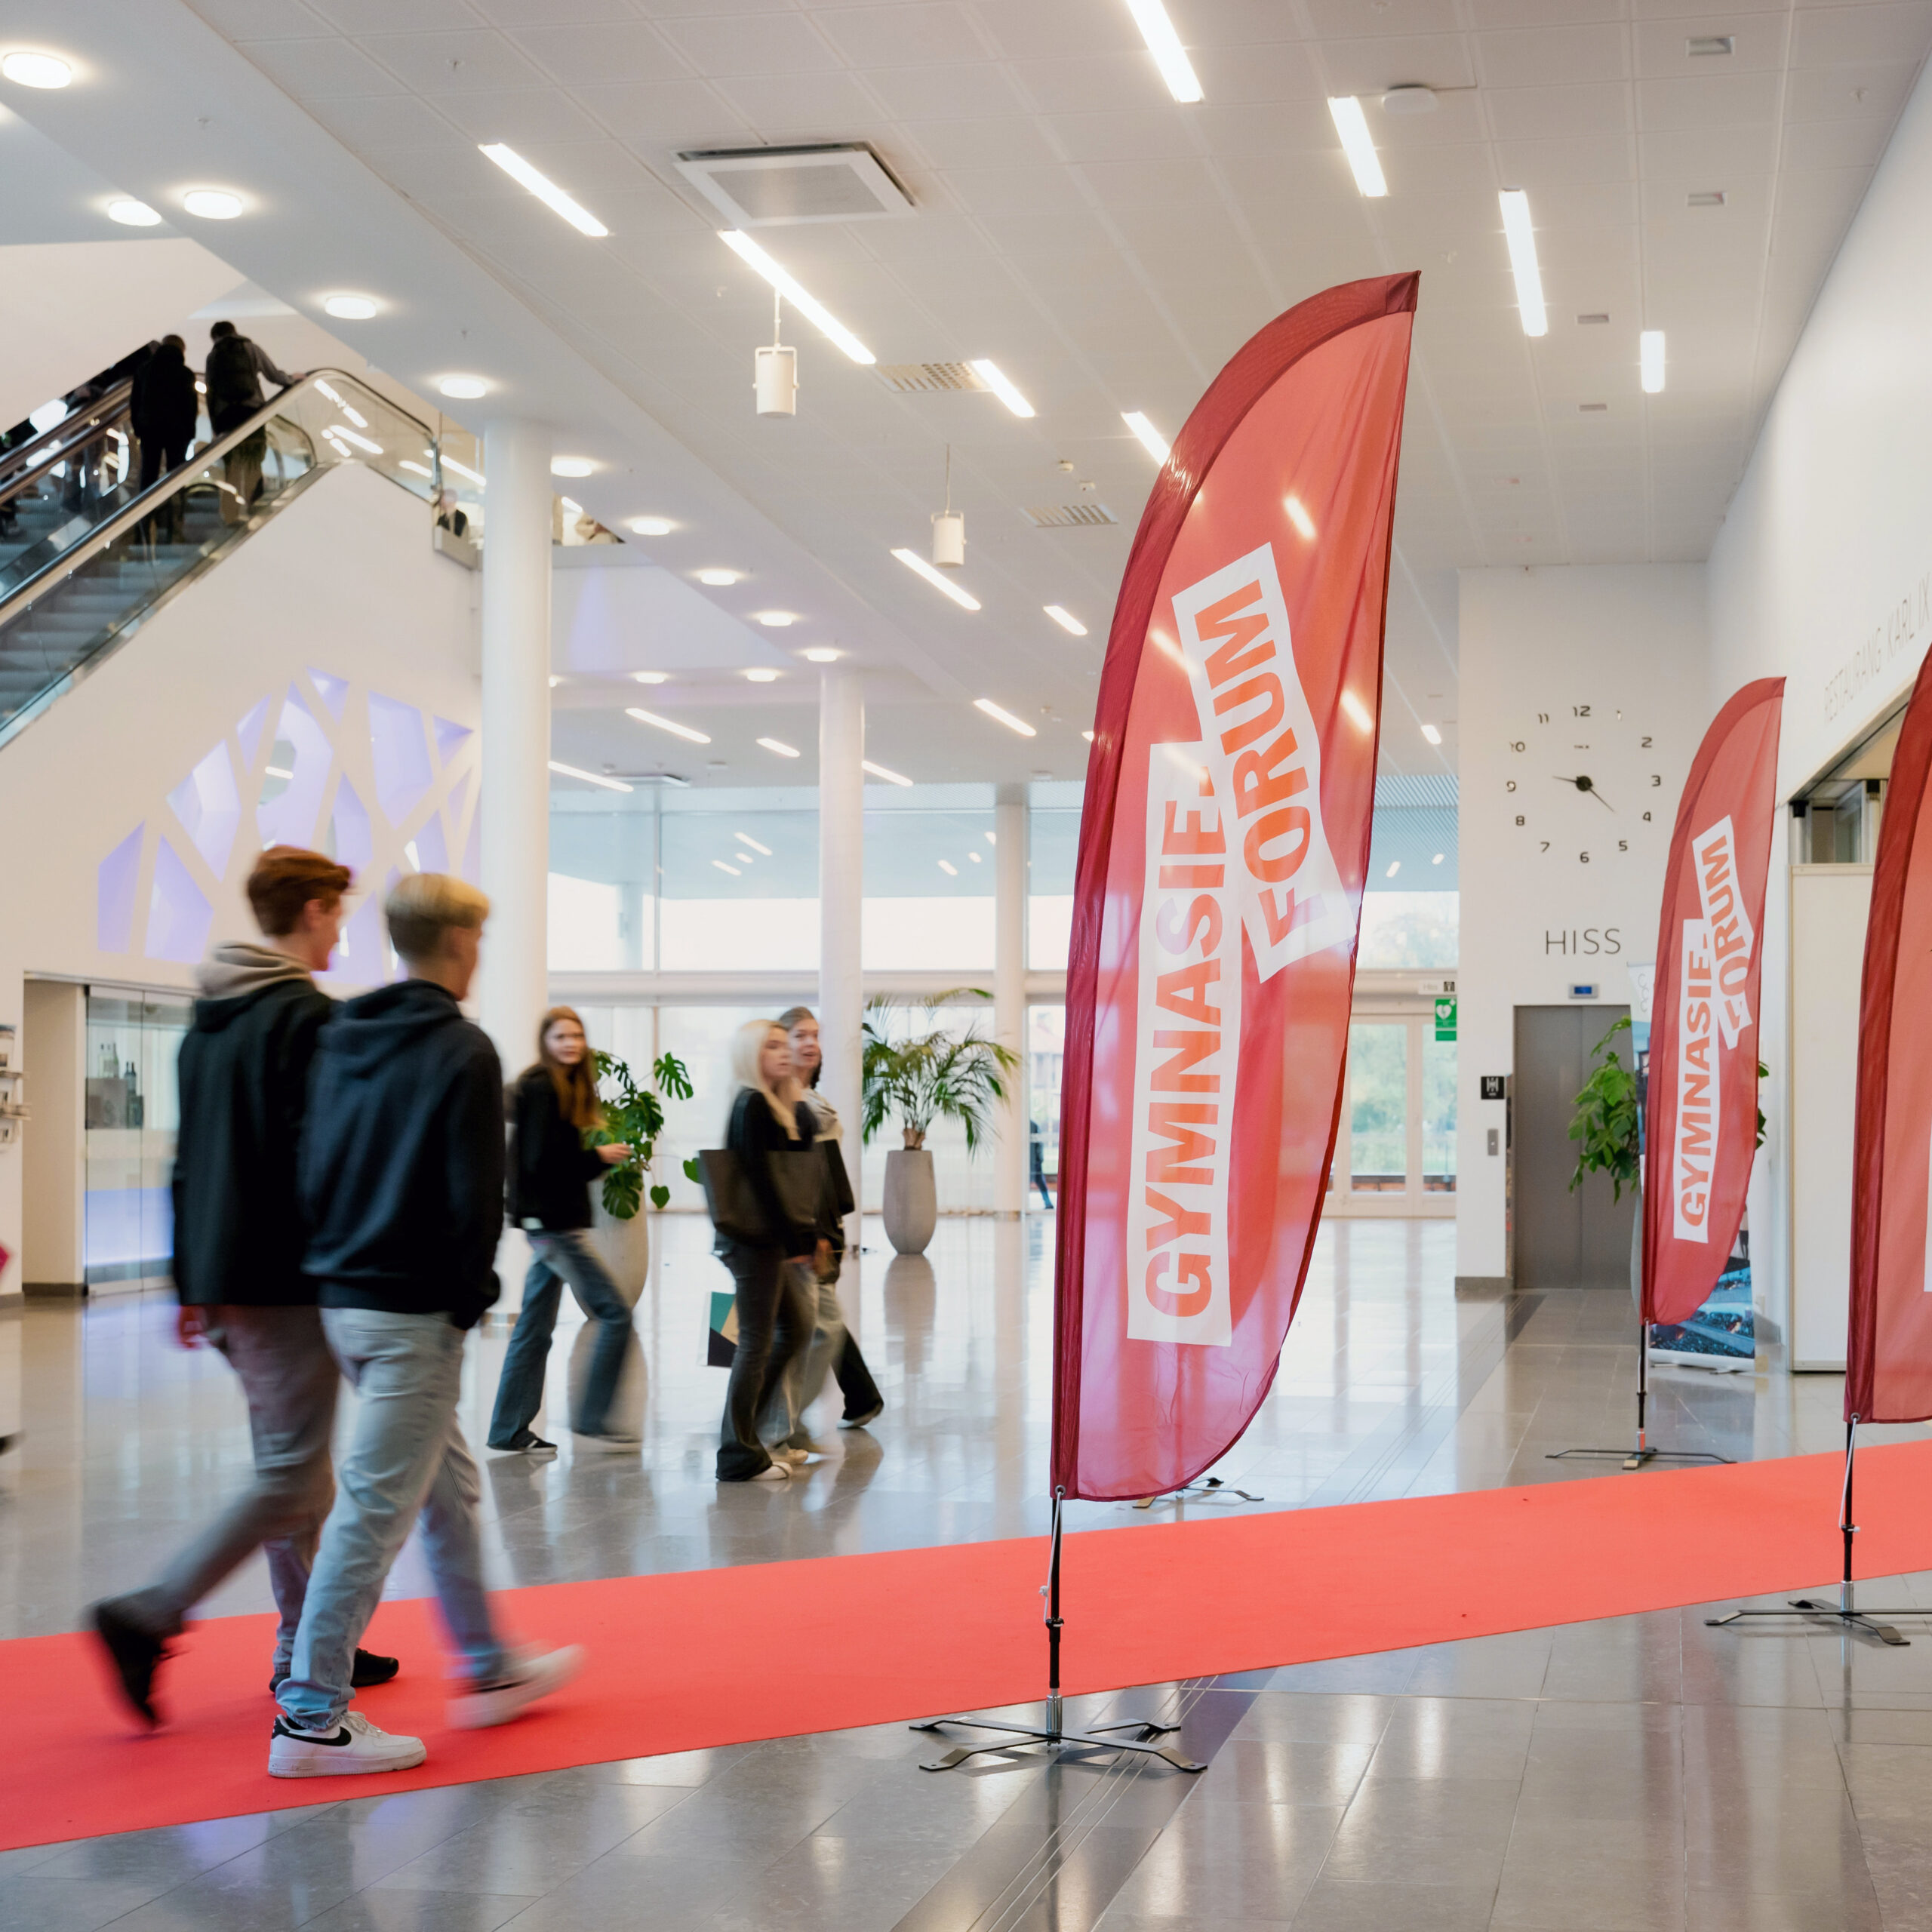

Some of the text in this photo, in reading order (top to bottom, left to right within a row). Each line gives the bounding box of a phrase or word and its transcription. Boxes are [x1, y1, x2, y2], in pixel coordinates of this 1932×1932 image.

[1824, 626, 1881, 727] RESTAURANG
[1887, 592, 1915, 663] KARL
[1573, 706, 1590, 717] 12
[1538, 713, 1549, 724] 11
[1509, 741, 1525, 752] 10
[1641, 737, 1652, 748] 2
[1195, 580, 1329, 948] FORUM
[1506, 780, 1516, 792] 9
[1651, 775, 1661, 786] 3
[1515, 815, 1525, 826] 8
[1642, 811, 1651, 822] 4
[1540, 841, 1549, 853] 7
[1618, 840, 1628, 851] 5
[1580, 851, 1589, 863] 6
[1546, 928, 1621, 955] HISS
